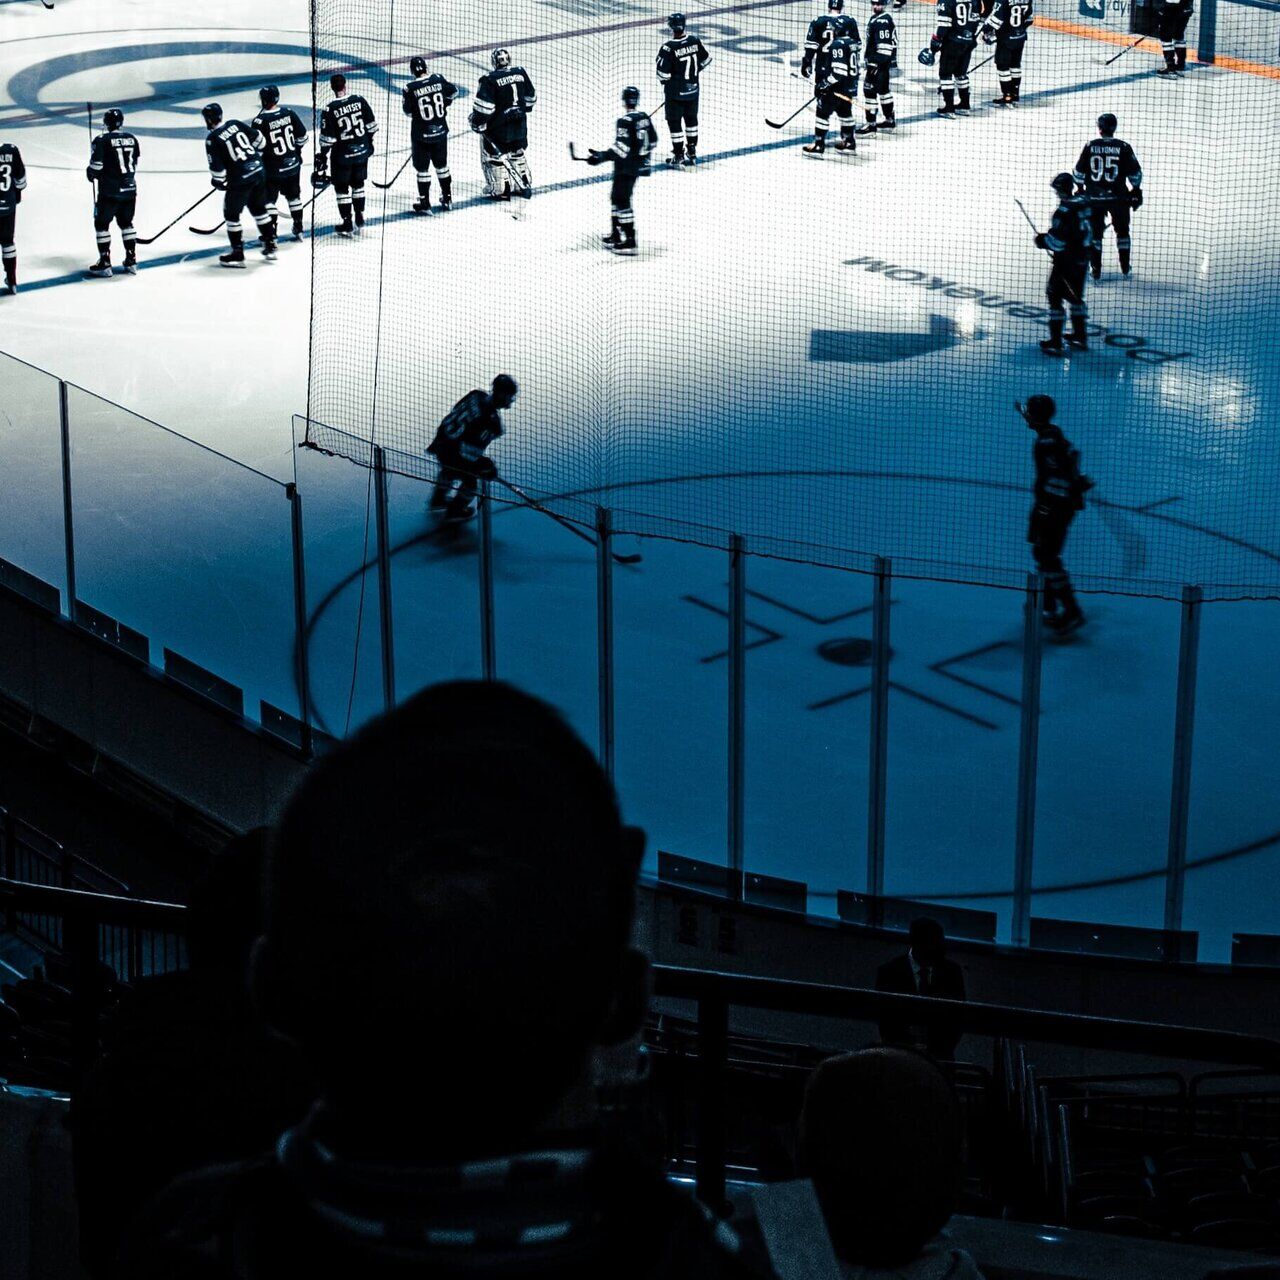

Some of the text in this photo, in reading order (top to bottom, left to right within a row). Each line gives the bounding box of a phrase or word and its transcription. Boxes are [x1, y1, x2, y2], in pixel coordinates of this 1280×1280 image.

[1009, 5, 1029, 28] 87
[879, 30, 890, 40] 86
[679, 54, 699, 80] 71
[832, 48, 844, 59] 99
[418, 92, 444, 121] 68
[510, 83, 519, 106] 1
[339, 111, 366, 141] 25
[225, 132, 256, 162] 49
[269, 127, 296, 157] 56
[115, 147, 135, 174] 17
[1090, 155, 1121, 183] 95
